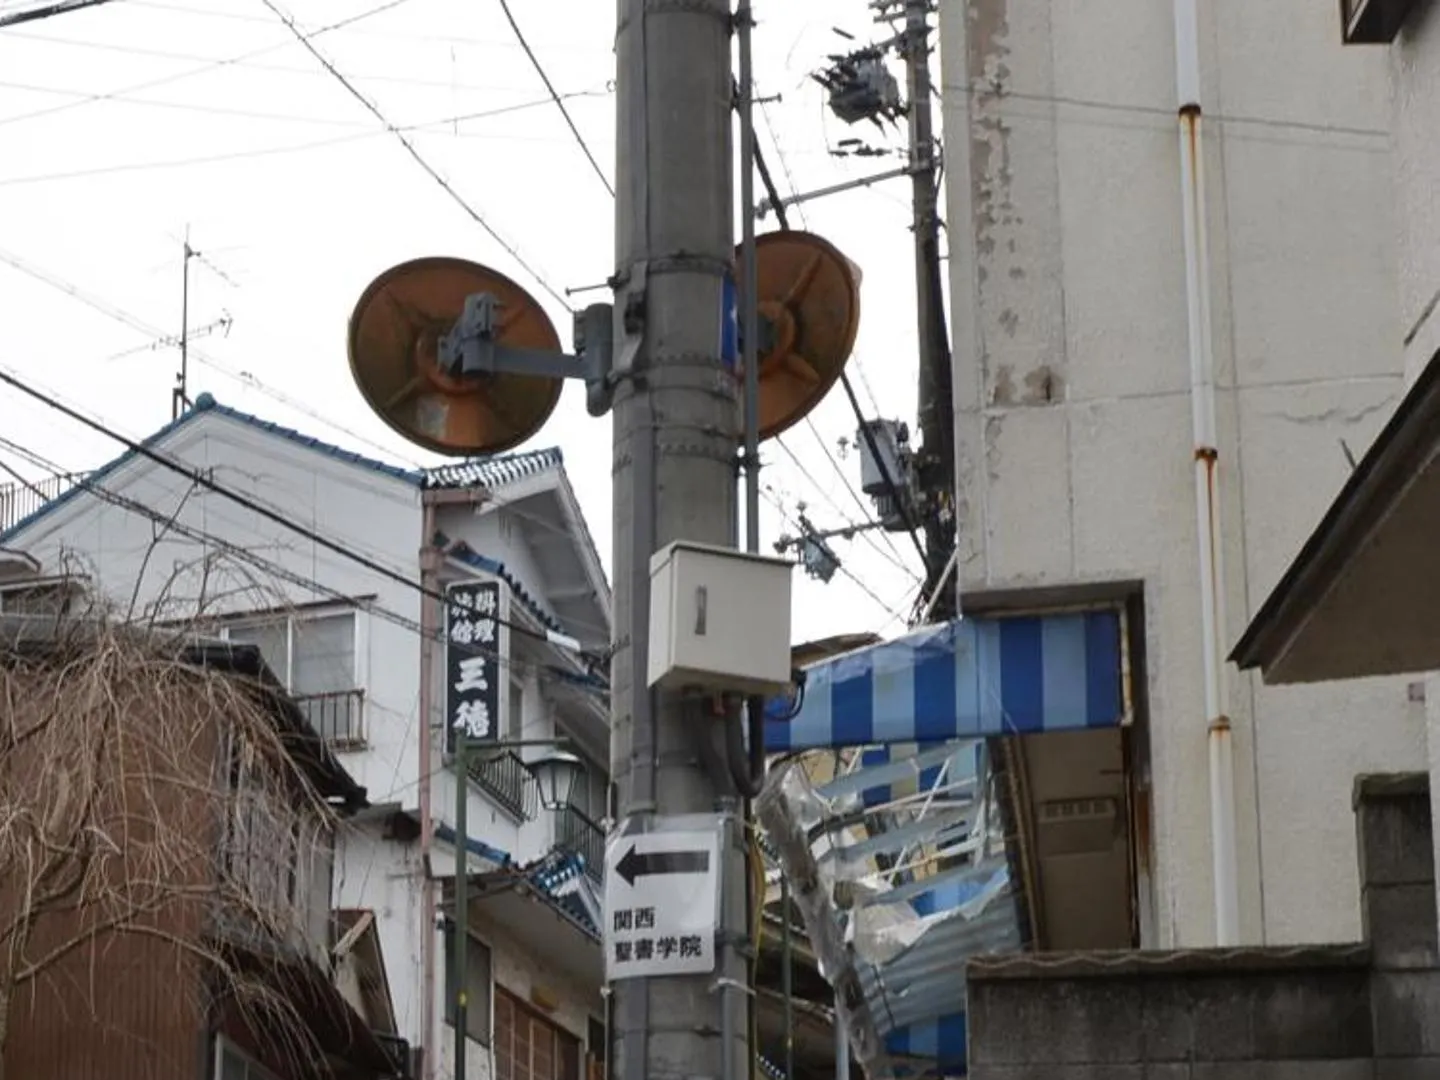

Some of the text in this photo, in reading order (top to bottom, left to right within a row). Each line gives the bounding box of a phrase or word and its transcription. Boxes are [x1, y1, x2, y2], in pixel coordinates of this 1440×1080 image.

[614, 906, 655, 931] 関西
[614, 934, 702, 963] 聖書学院
